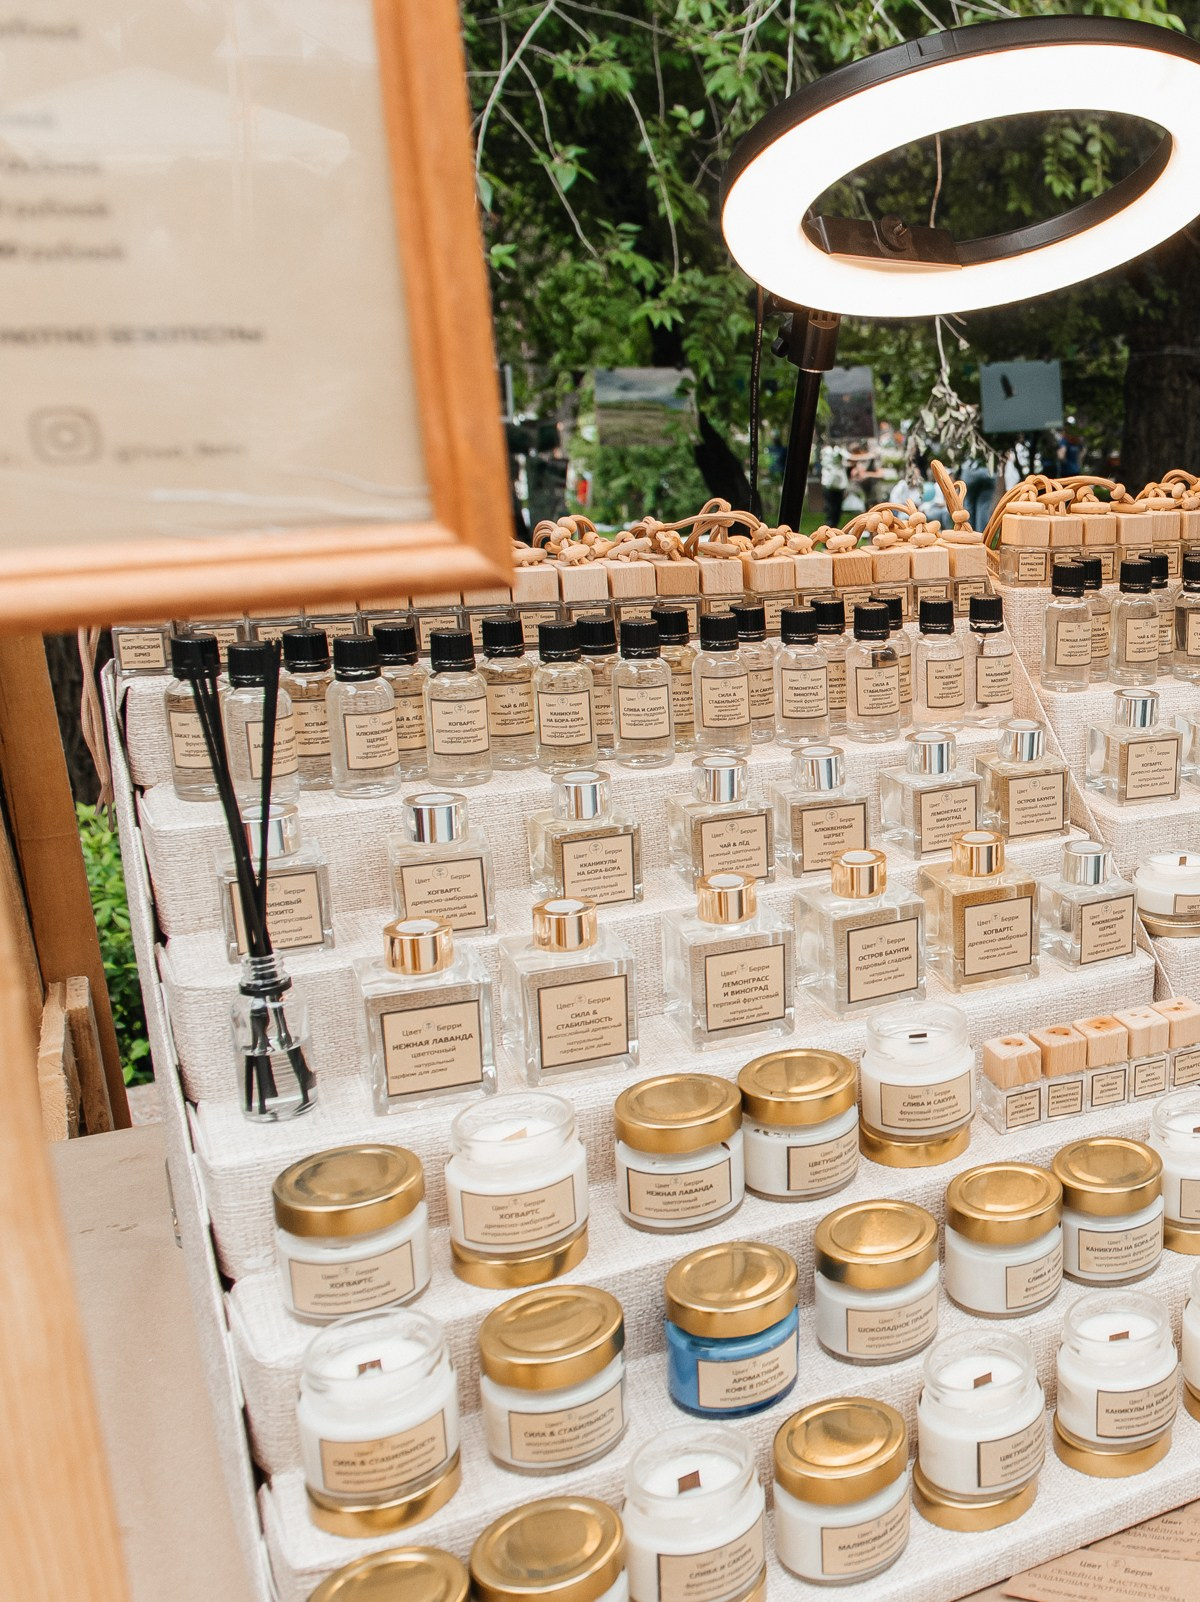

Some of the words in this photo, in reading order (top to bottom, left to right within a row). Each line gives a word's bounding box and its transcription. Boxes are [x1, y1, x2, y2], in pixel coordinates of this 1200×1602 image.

[122, 643, 161, 651] КАРИБСКИЙ
[708, 697, 745, 705] СТАБИЛЬНОСТЬ
[356, 727, 393, 735] КЛЮКВЕННЫЙ
[1037, 795, 1056, 803] БАУНТИ
[931, 807, 961, 817] ЛЕМОНГРАСС
[936, 814, 961, 822] ВИНОГРАД
[815, 824, 853, 833] КЛЮКВЕННЫЙ
[580, 859, 617, 868] ККАНИКУЛЫ
[587, 866, 620, 874] БОРА-БОРА
[428, 888, 461, 896] ХОГВАРТС
[1001, 914, 1019, 922] Берри
[1092, 915, 1124, 926] КЛЮКВЕННЫЙ
[983, 925, 1013, 936] ХОГВАРТС
[1098, 924, 1117, 932] ЩЕРБЕТ
[862, 942, 877, 950] Цвет
[886, 936, 905, 944] Берри
[968, 932, 1028, 947] древесно-амбровый
[858, 954, 883, 962] ОСТРОВ
[885, 947, 910, 957] БАУНТИ
[749, 964, 770, 972] Берри
[855, 960, 886, 971] пудровый
[888, 955, 912, 965] сладкий
[721, 975, 769, 988] ЛЕМОНГРАСС
[731, 985, 769, 996] ВИНОГРАД
[588, 995, 611, 1004] Берри
[712, 999, 740, 1008] терпкий
[742, 992, 779, 1006] фруктовый
[570, 1011, 590, 1019] СИЛА
[556, 1016, 613, 1030] СТАБИЛЬНОСТЬ
[402, 1028, 422, 1037] Цвет
[436, 1022, 462, 1032] Берри
[392, 1040, 429, 1050] НЕЖНАЯ
[432, 1033, 474, 1045] ЛАВАНДА
[411, 1046, 456, 1058] цветочный
[903, 1100, 925, 1108] СЛИВА
[933, 1094, 957, 1105] САКУРА
[683, 1178, 704, 1186] Берри
[646, 1189, 677, 1197] НЕЖНАЯ
[678, 1183, 714, 1196] ЛАВАНДА
[498, 1208, 541, 1220] ХОГВАРТС
[329, 1276, 374, 1289] ХОГВАРТС
[732, 1364, 780, 1384] АРОМАТНЫЙ
[726, 1385, 747, 1394] КОФЕ
[756, 1370, 784, 1388] ПОСТЕЛЬ
[1105, 1404, 1144, 1415] КАНИКУЛЫ
[838, 1530, 888, 1552] МАЛИНОВЫЙ
[1080, 1561, 1102, 1569] Цвет
[1123, 1568, 1153, 1577] Берри
